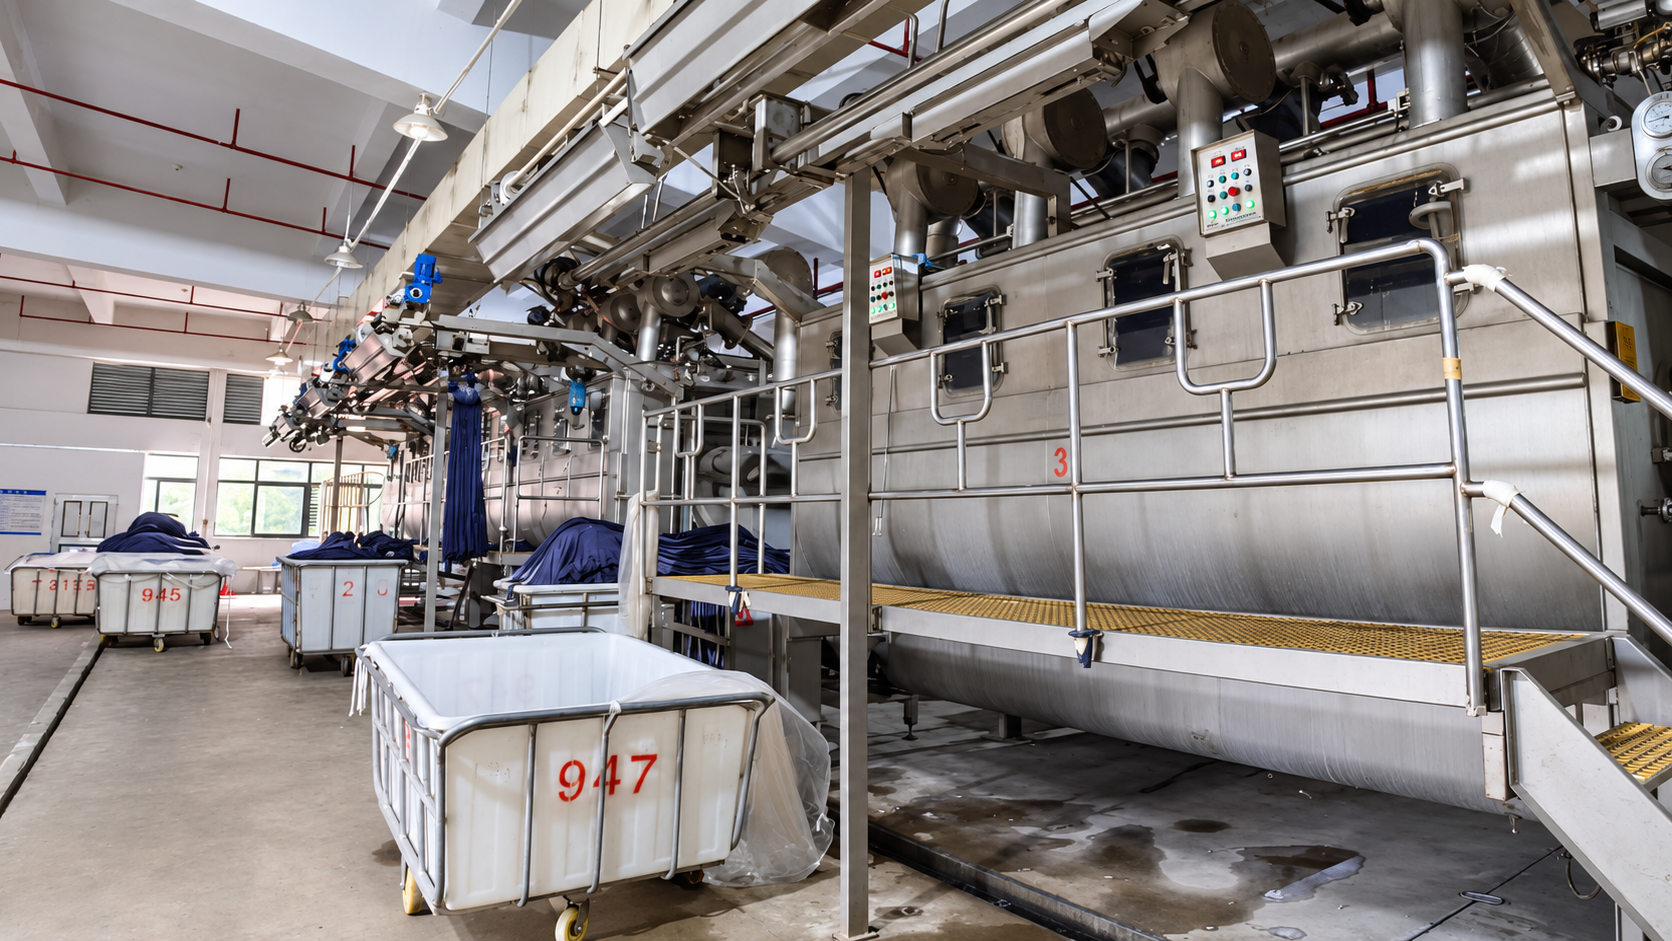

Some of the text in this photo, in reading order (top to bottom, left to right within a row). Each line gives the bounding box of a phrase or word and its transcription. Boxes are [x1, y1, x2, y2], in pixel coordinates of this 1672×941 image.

[1054, 447, 1068, 477] 3
[142, 587, 181, 602] 945
[558, 753, 658, 802] 947
